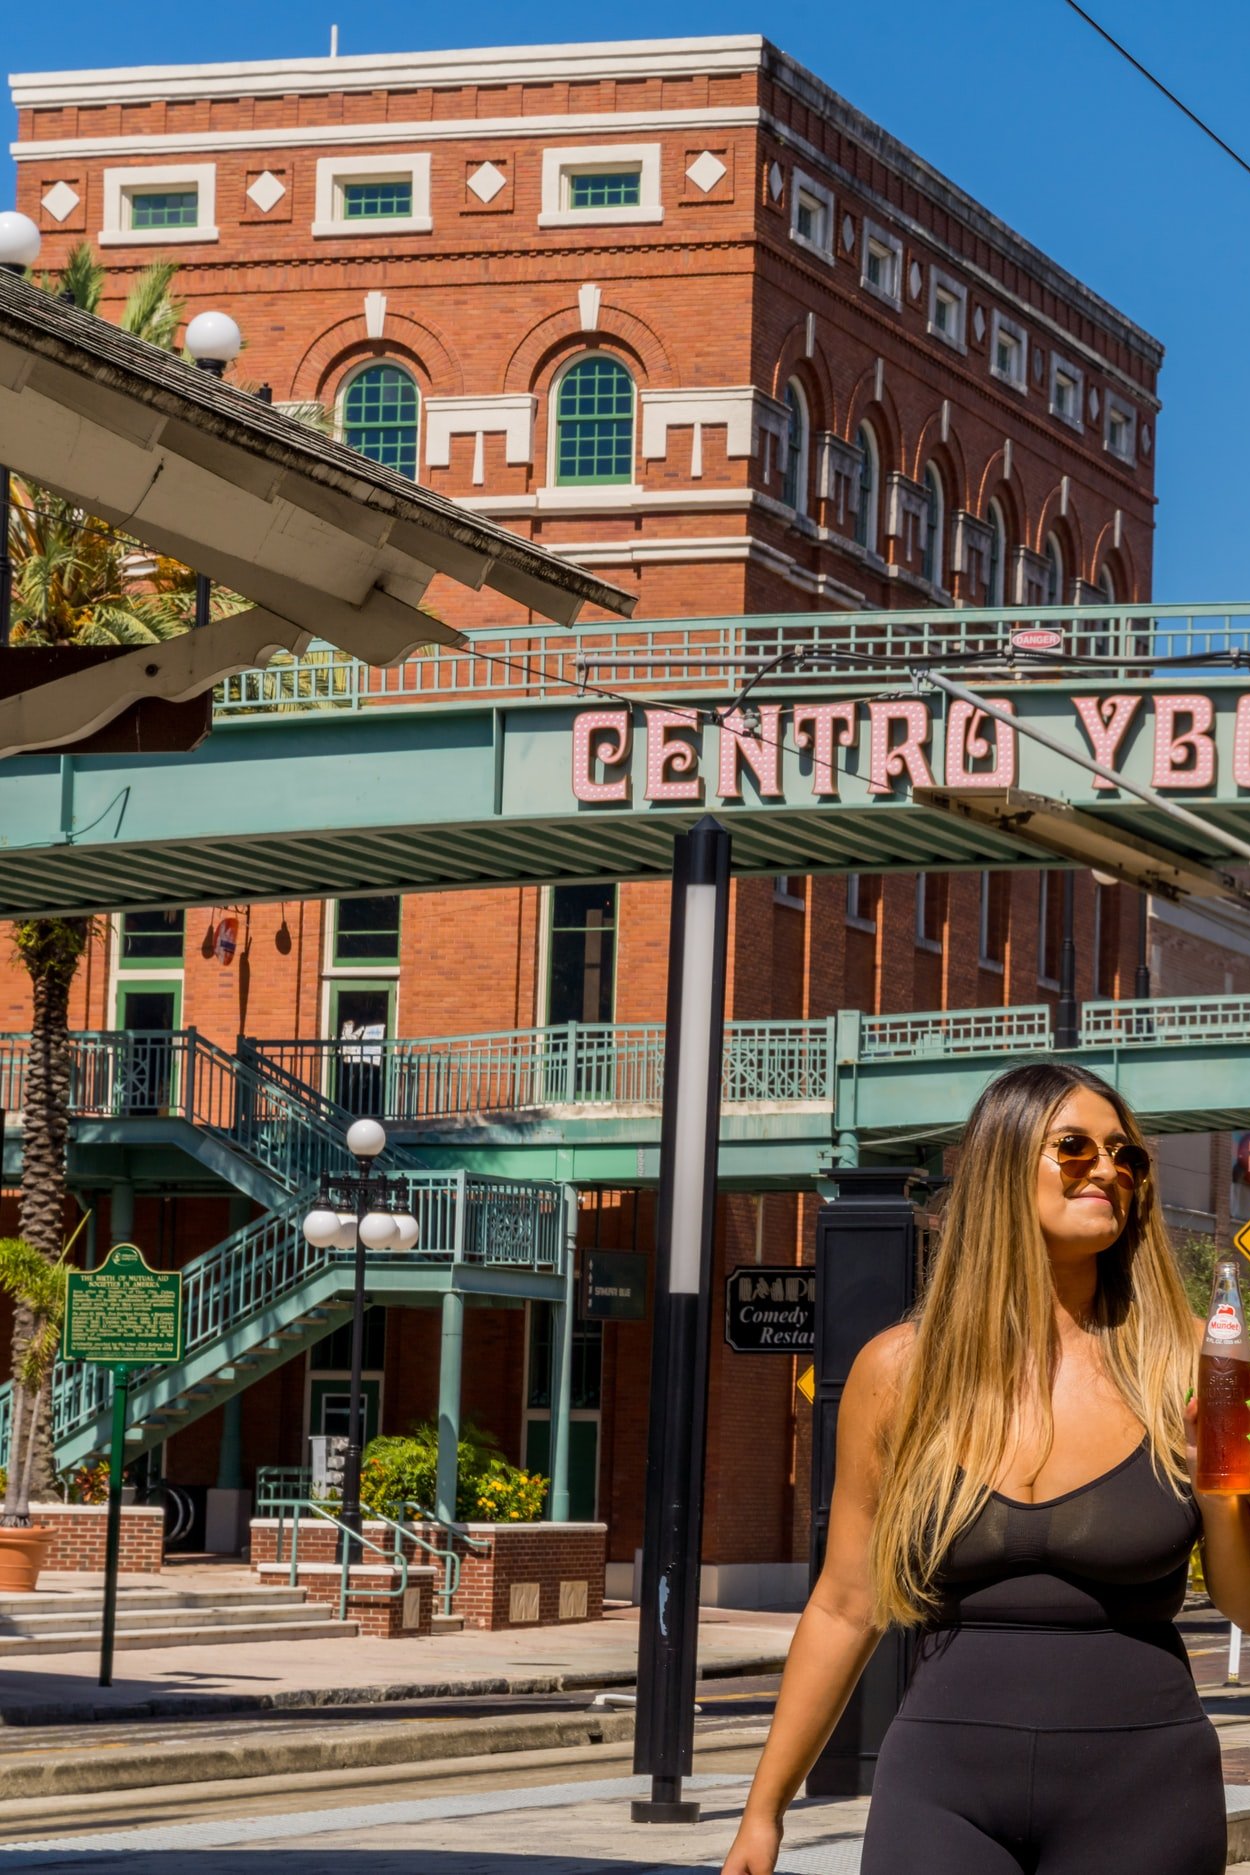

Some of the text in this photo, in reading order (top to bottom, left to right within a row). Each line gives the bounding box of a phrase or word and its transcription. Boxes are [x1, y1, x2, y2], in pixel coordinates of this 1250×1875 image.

[1016, 635, 1057, 645] DANGER
[572, 698, 1018, 803] CENTRO
[739, 1306, 808, 1328] Comedy
[1211, 1321, 1239, 1331] Mundet
